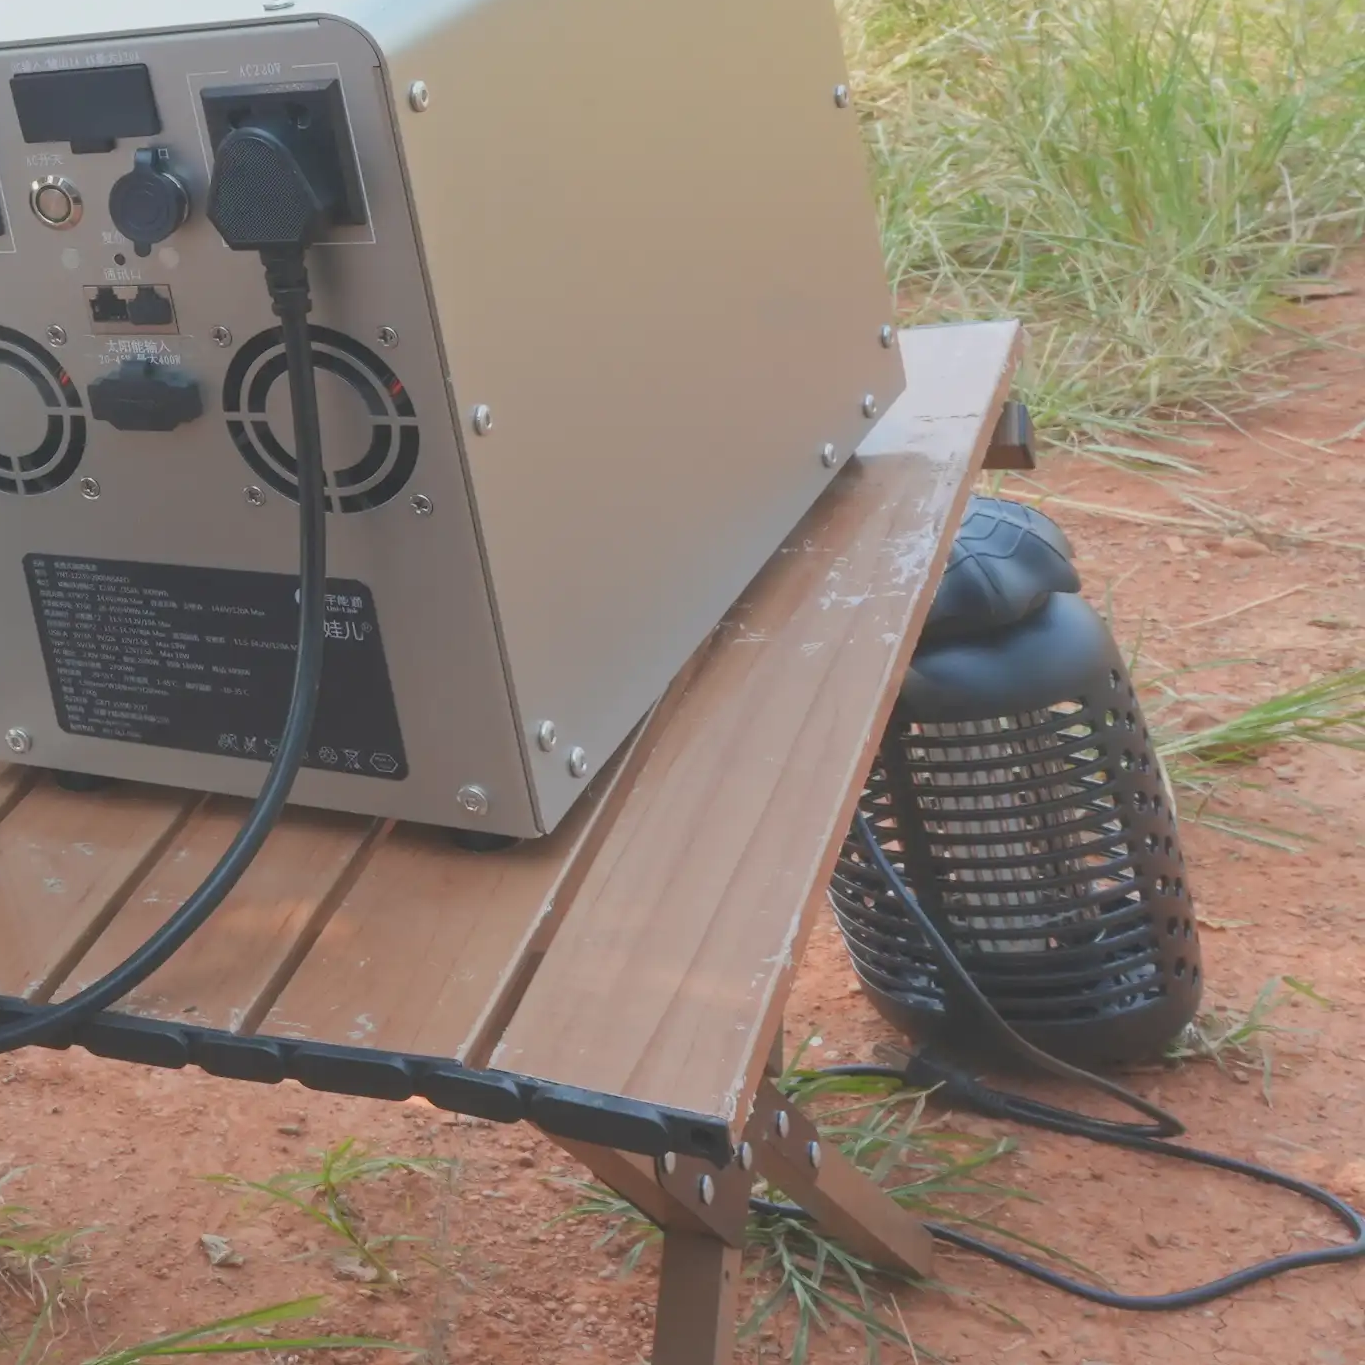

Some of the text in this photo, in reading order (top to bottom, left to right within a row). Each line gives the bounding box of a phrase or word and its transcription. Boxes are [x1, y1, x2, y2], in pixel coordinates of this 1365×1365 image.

[105, 339, 171, 355] 太阳能输入
